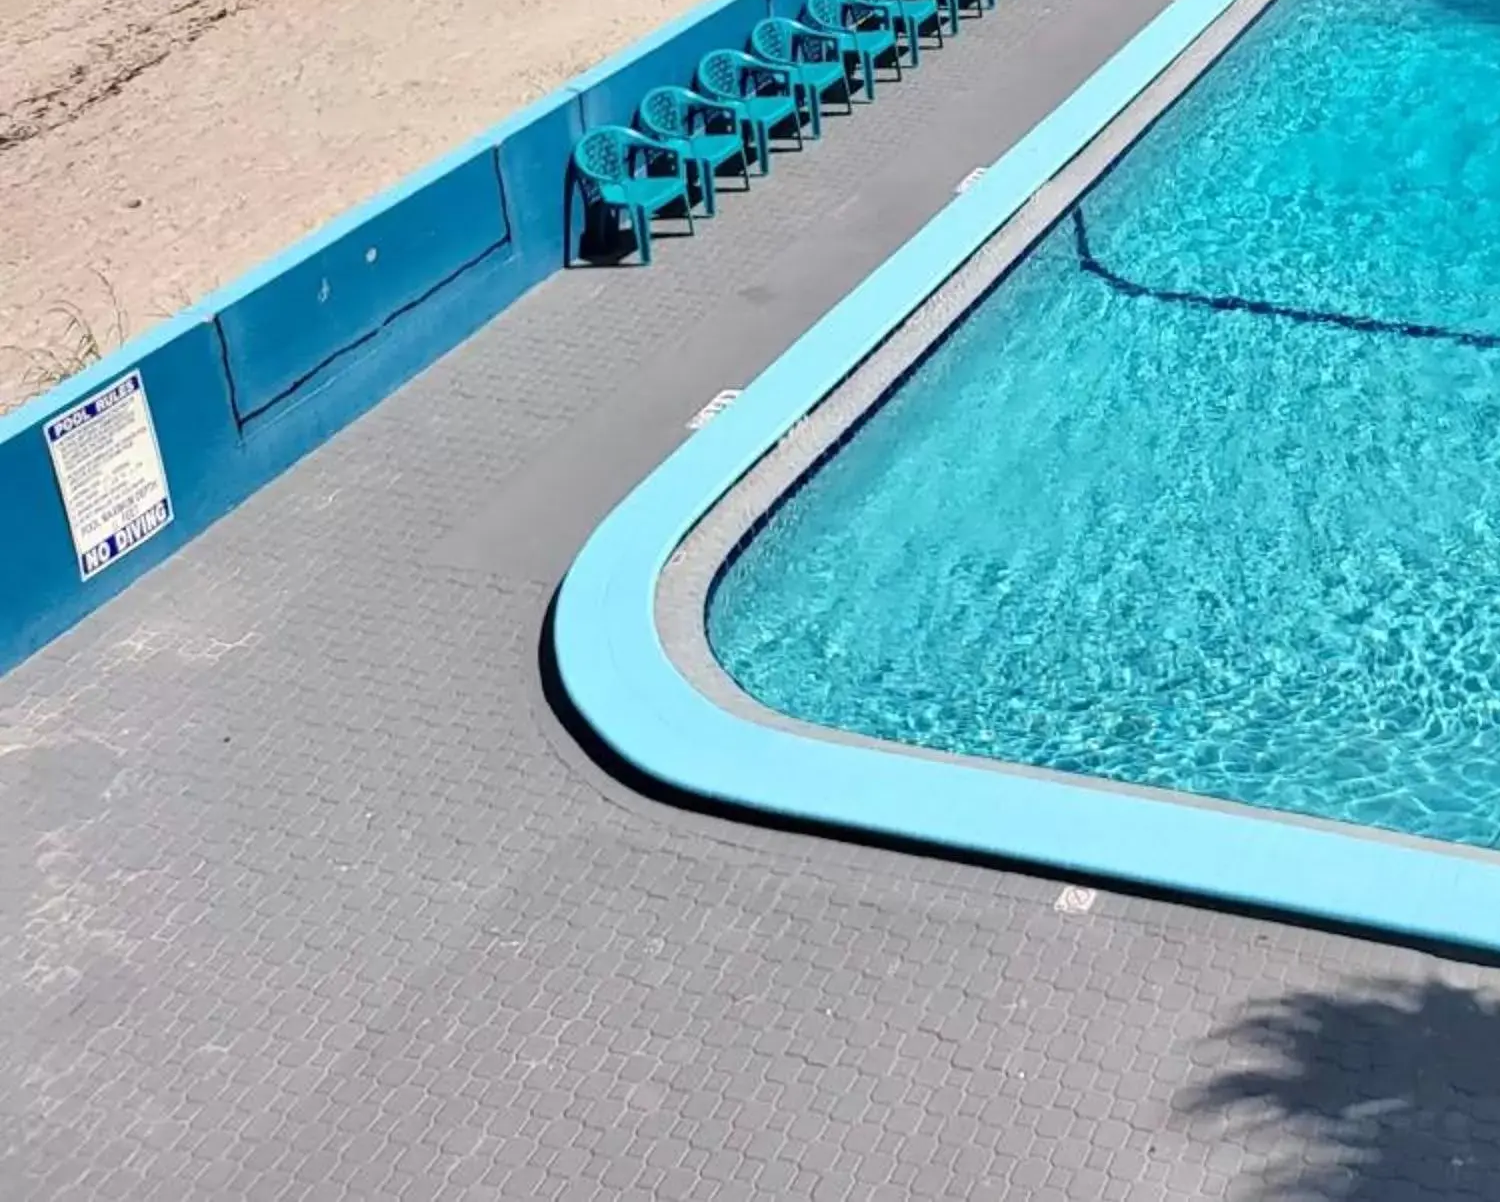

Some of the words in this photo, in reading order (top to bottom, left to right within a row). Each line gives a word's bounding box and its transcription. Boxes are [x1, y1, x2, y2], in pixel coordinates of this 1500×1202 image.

[54, 407, 91, 437] POOL
[95, 378, 136, 414] RULES
[85, 541, 111, 570] NO
[115, 503, 167, 551] DIVING
